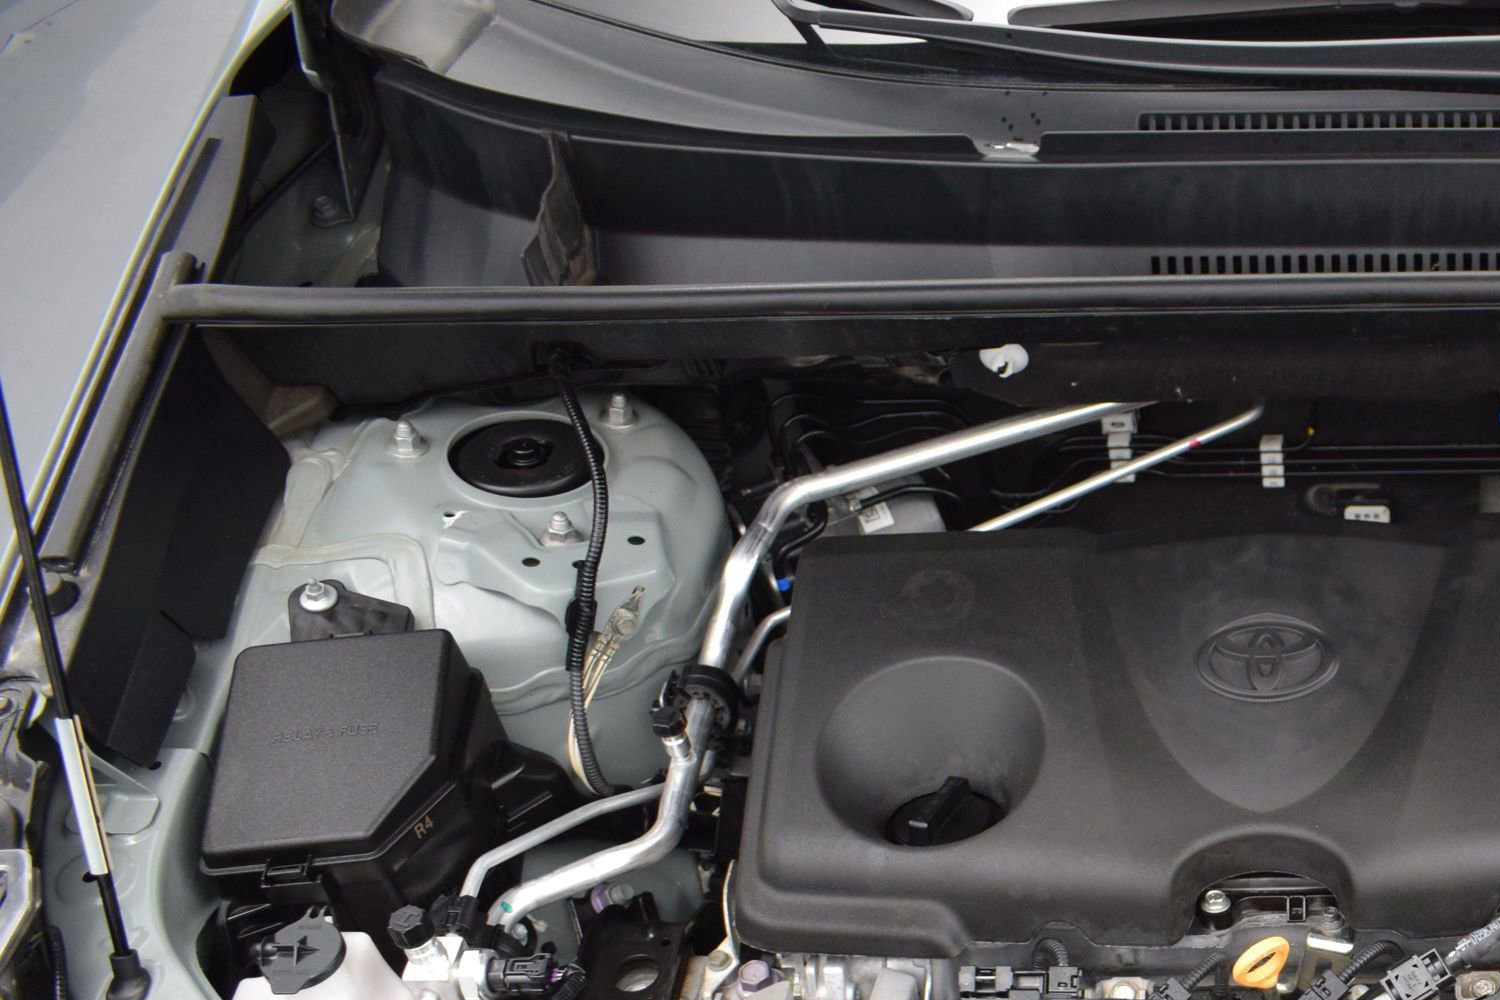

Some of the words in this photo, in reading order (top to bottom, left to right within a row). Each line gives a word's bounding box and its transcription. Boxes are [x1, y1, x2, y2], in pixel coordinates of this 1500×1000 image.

[272, 727, 324, 744] RELAY
[324, 728, 336, 739] &
[339, 721, 381, 737] FUSE
[413, 815, 434, 839] R4
